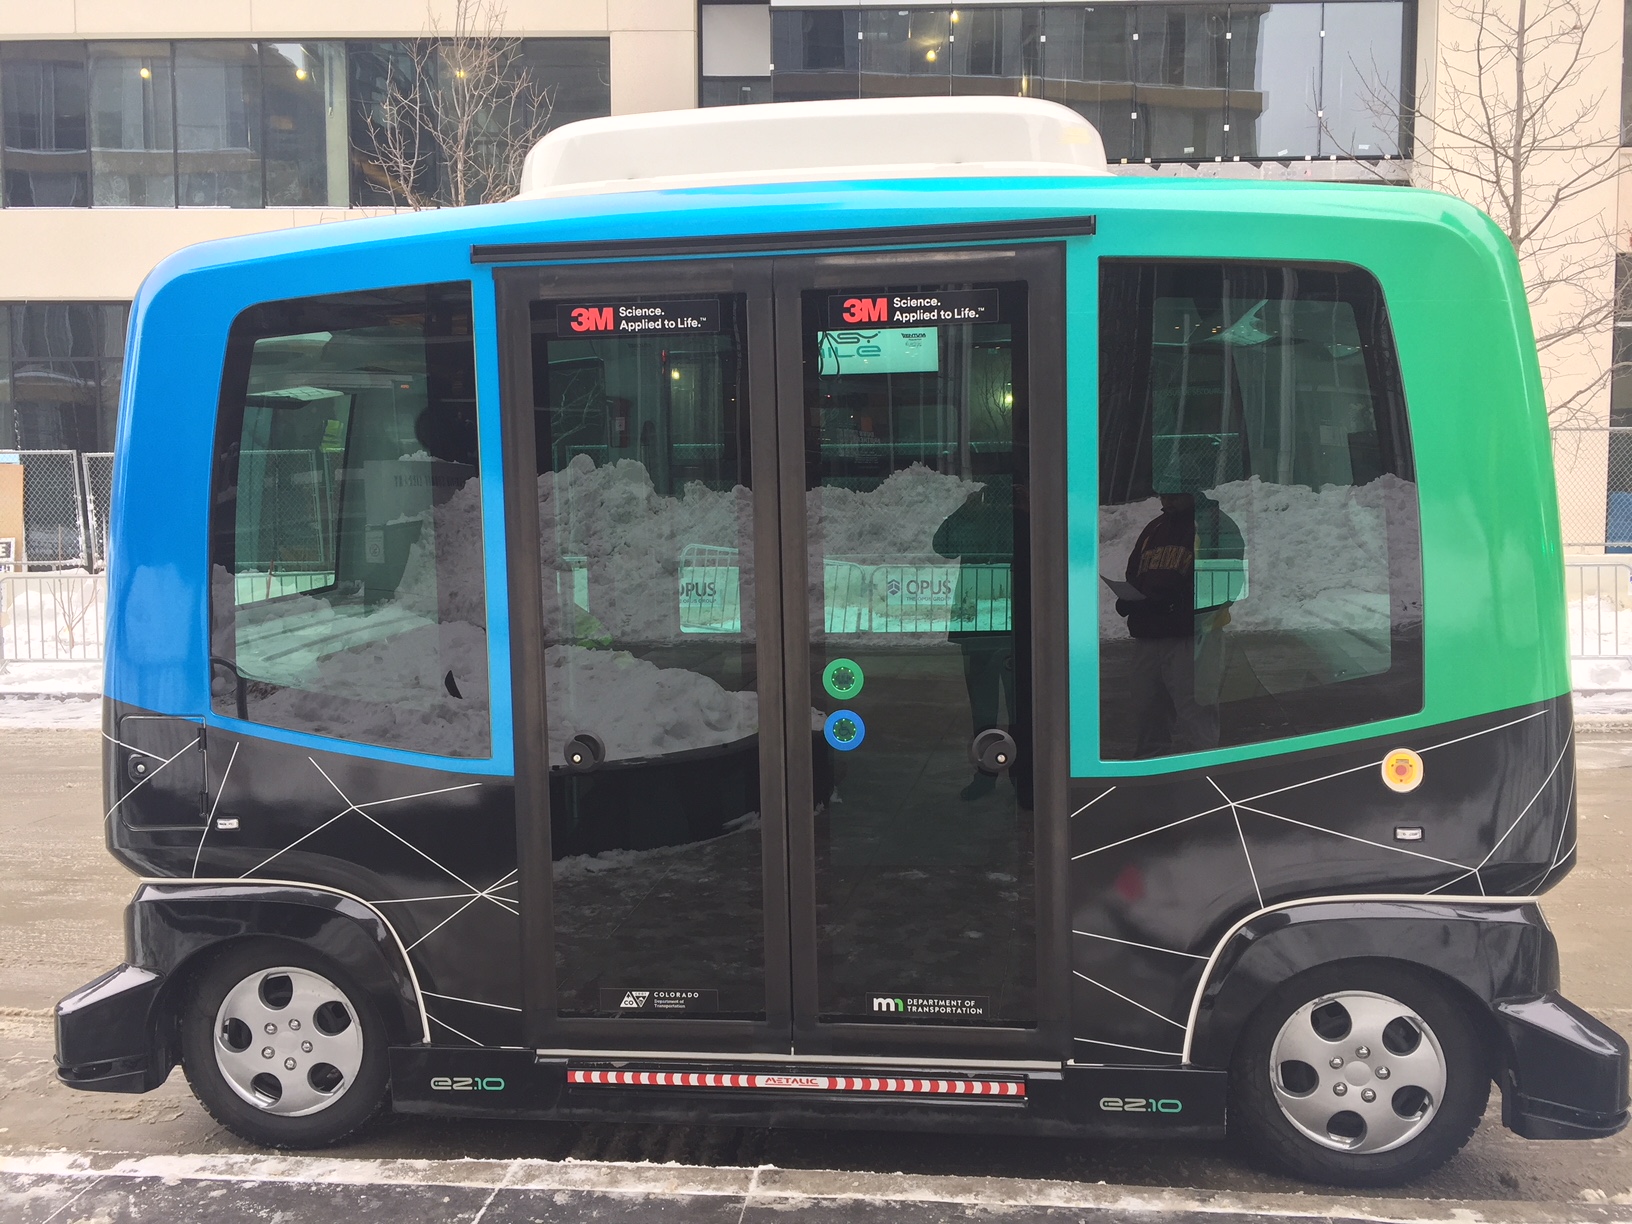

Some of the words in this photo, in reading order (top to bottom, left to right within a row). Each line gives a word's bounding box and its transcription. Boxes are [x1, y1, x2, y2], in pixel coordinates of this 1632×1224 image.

[893, 297, 941, 308] Science.
[619, 306, 665, 317] Science.
[842, 297, 888, 323] 3M
[893, 309, 938, 323] Applied
[940, 310, 953, 319] to
[570, 307, 614, 332] 3M
[620, 319, 662, 332] Applied
[664, 319, 676, 329] to
[906, 580, 952, 595] OPUS
[907, 998, 961, 1007] DEPARTMENT
[907, 1006, 983, 1014] TRANSPORTATION
[765, 1077, 818, 1085] METALIC
